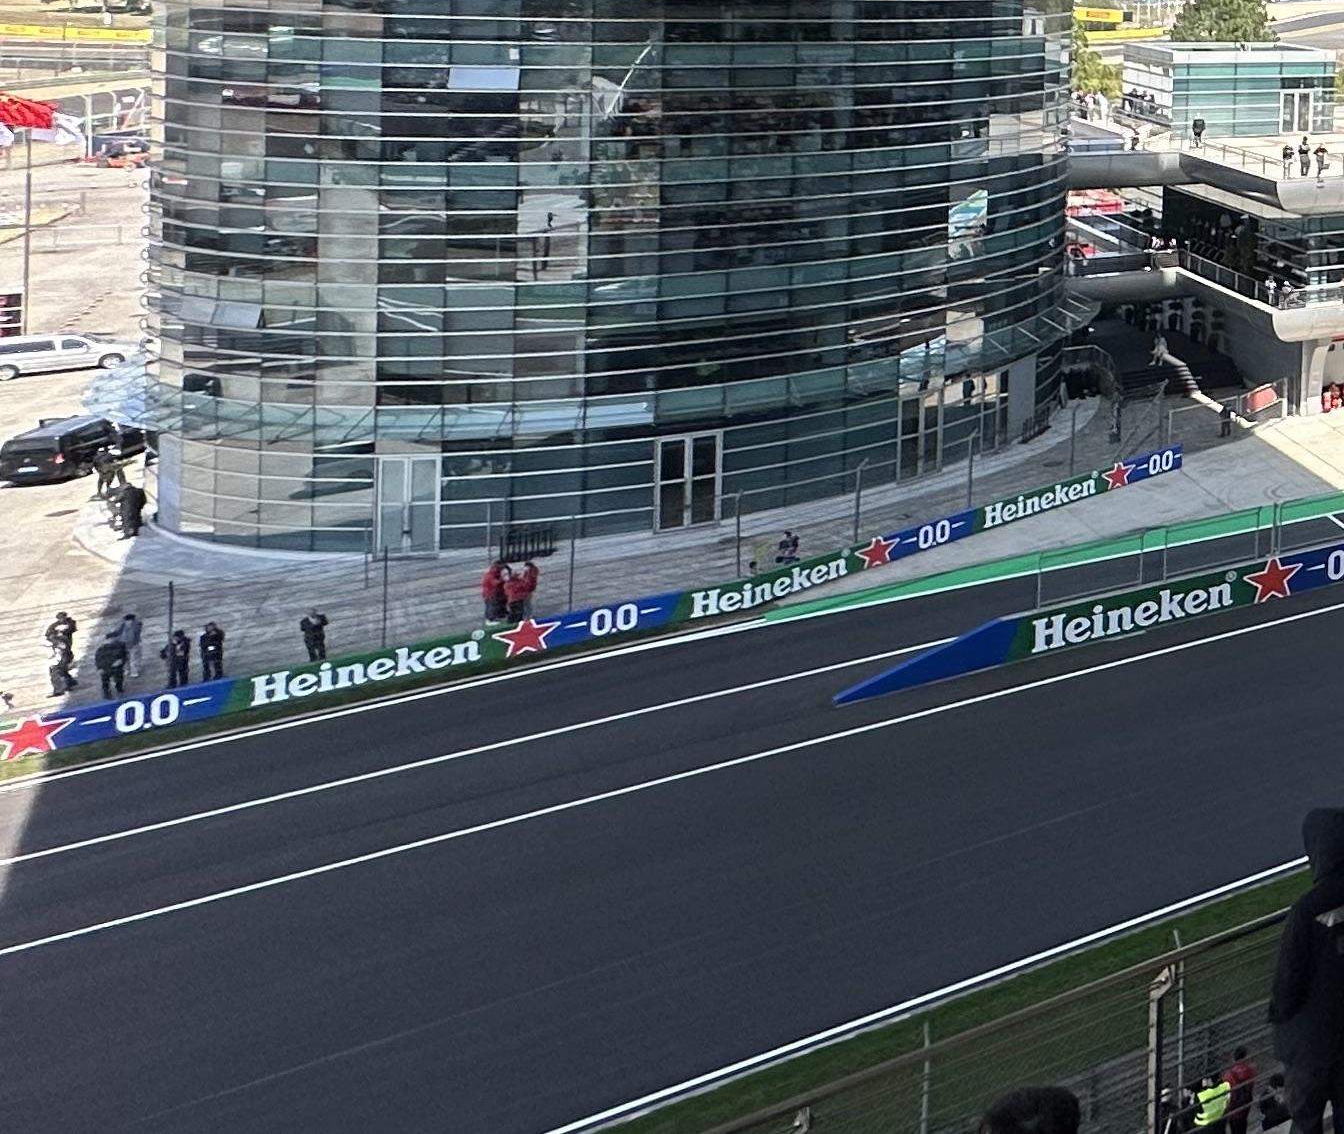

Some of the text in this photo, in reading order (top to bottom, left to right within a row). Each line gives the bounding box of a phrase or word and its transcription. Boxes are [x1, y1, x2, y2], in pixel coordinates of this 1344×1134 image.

[984, 477, 1097, 529] Heineken
[691, 557, 849, 618] Heineken
[1032, 580, 1232, 652] Heineken
[251, 639, 482, 706] Heineken
